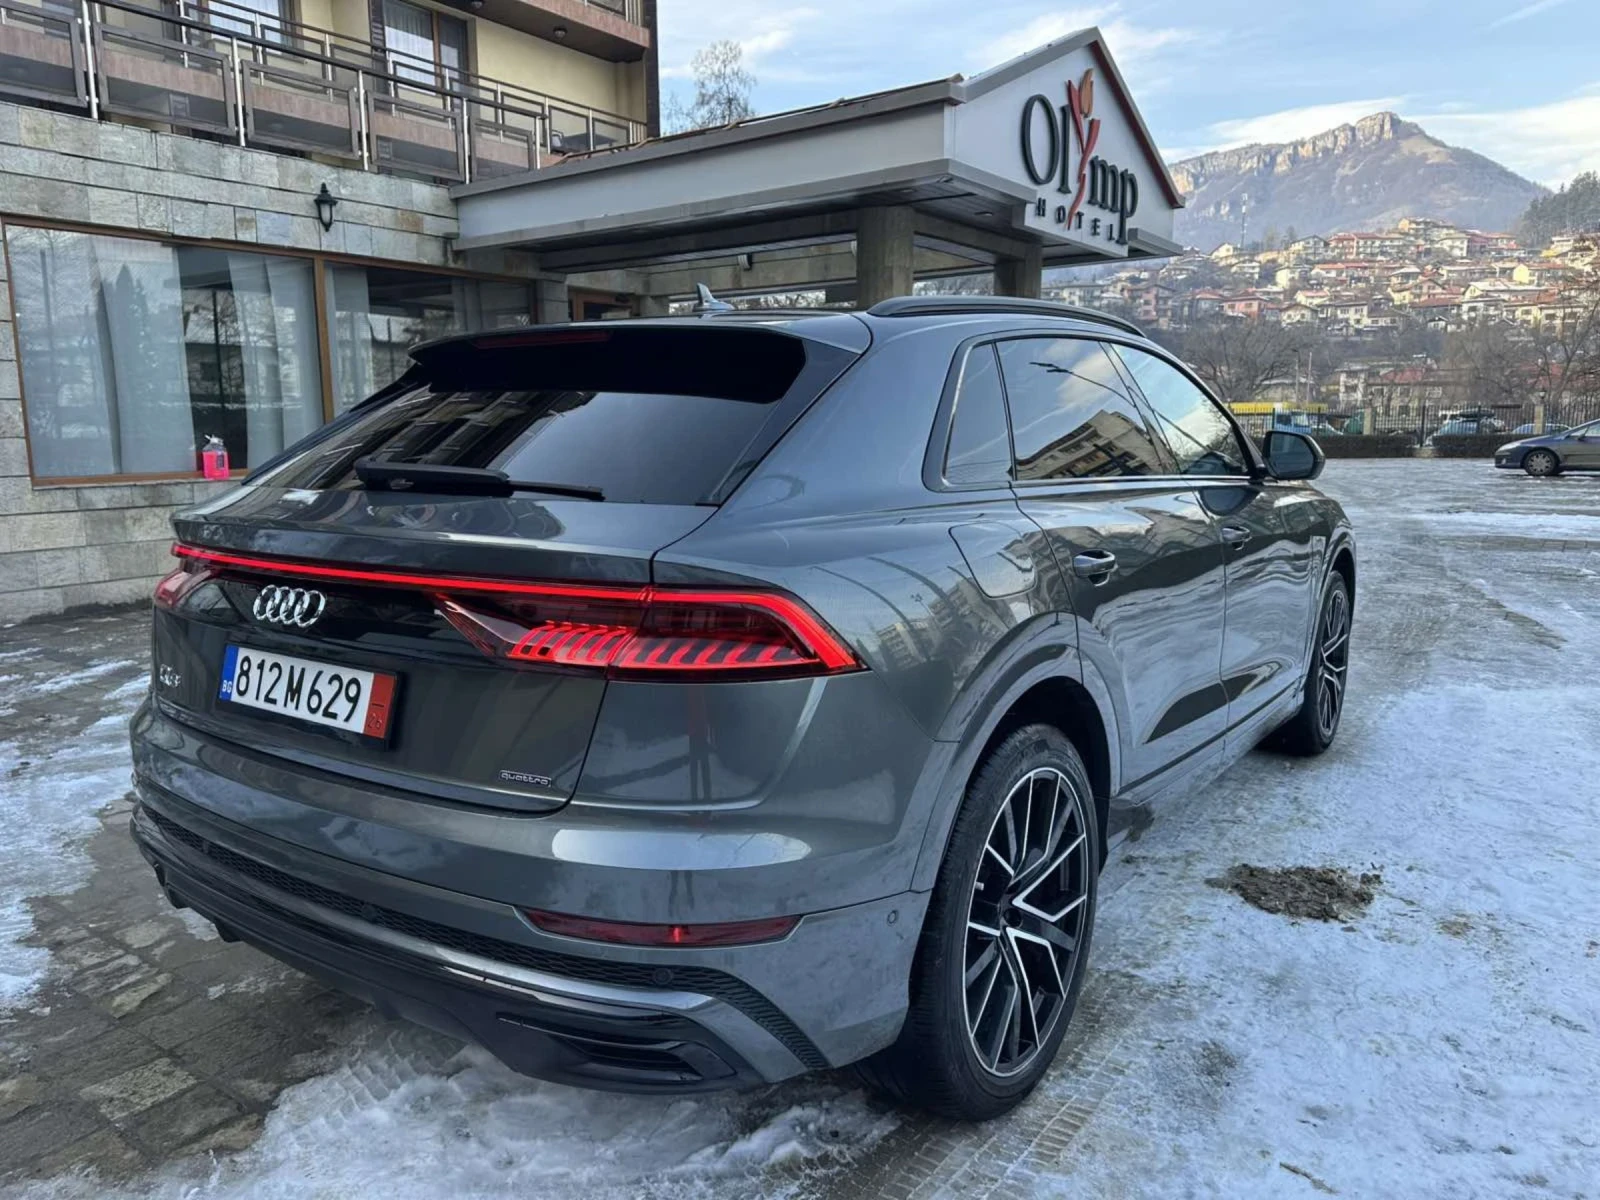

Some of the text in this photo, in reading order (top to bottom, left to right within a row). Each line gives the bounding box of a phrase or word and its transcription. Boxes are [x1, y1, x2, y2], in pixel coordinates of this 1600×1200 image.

[1036, 197, 1116, 241] HOTEL
[221, 679, 233, 694] BG
[236, 655, 361, 723] 812M629
[501, 771, 549, 786] quattro
